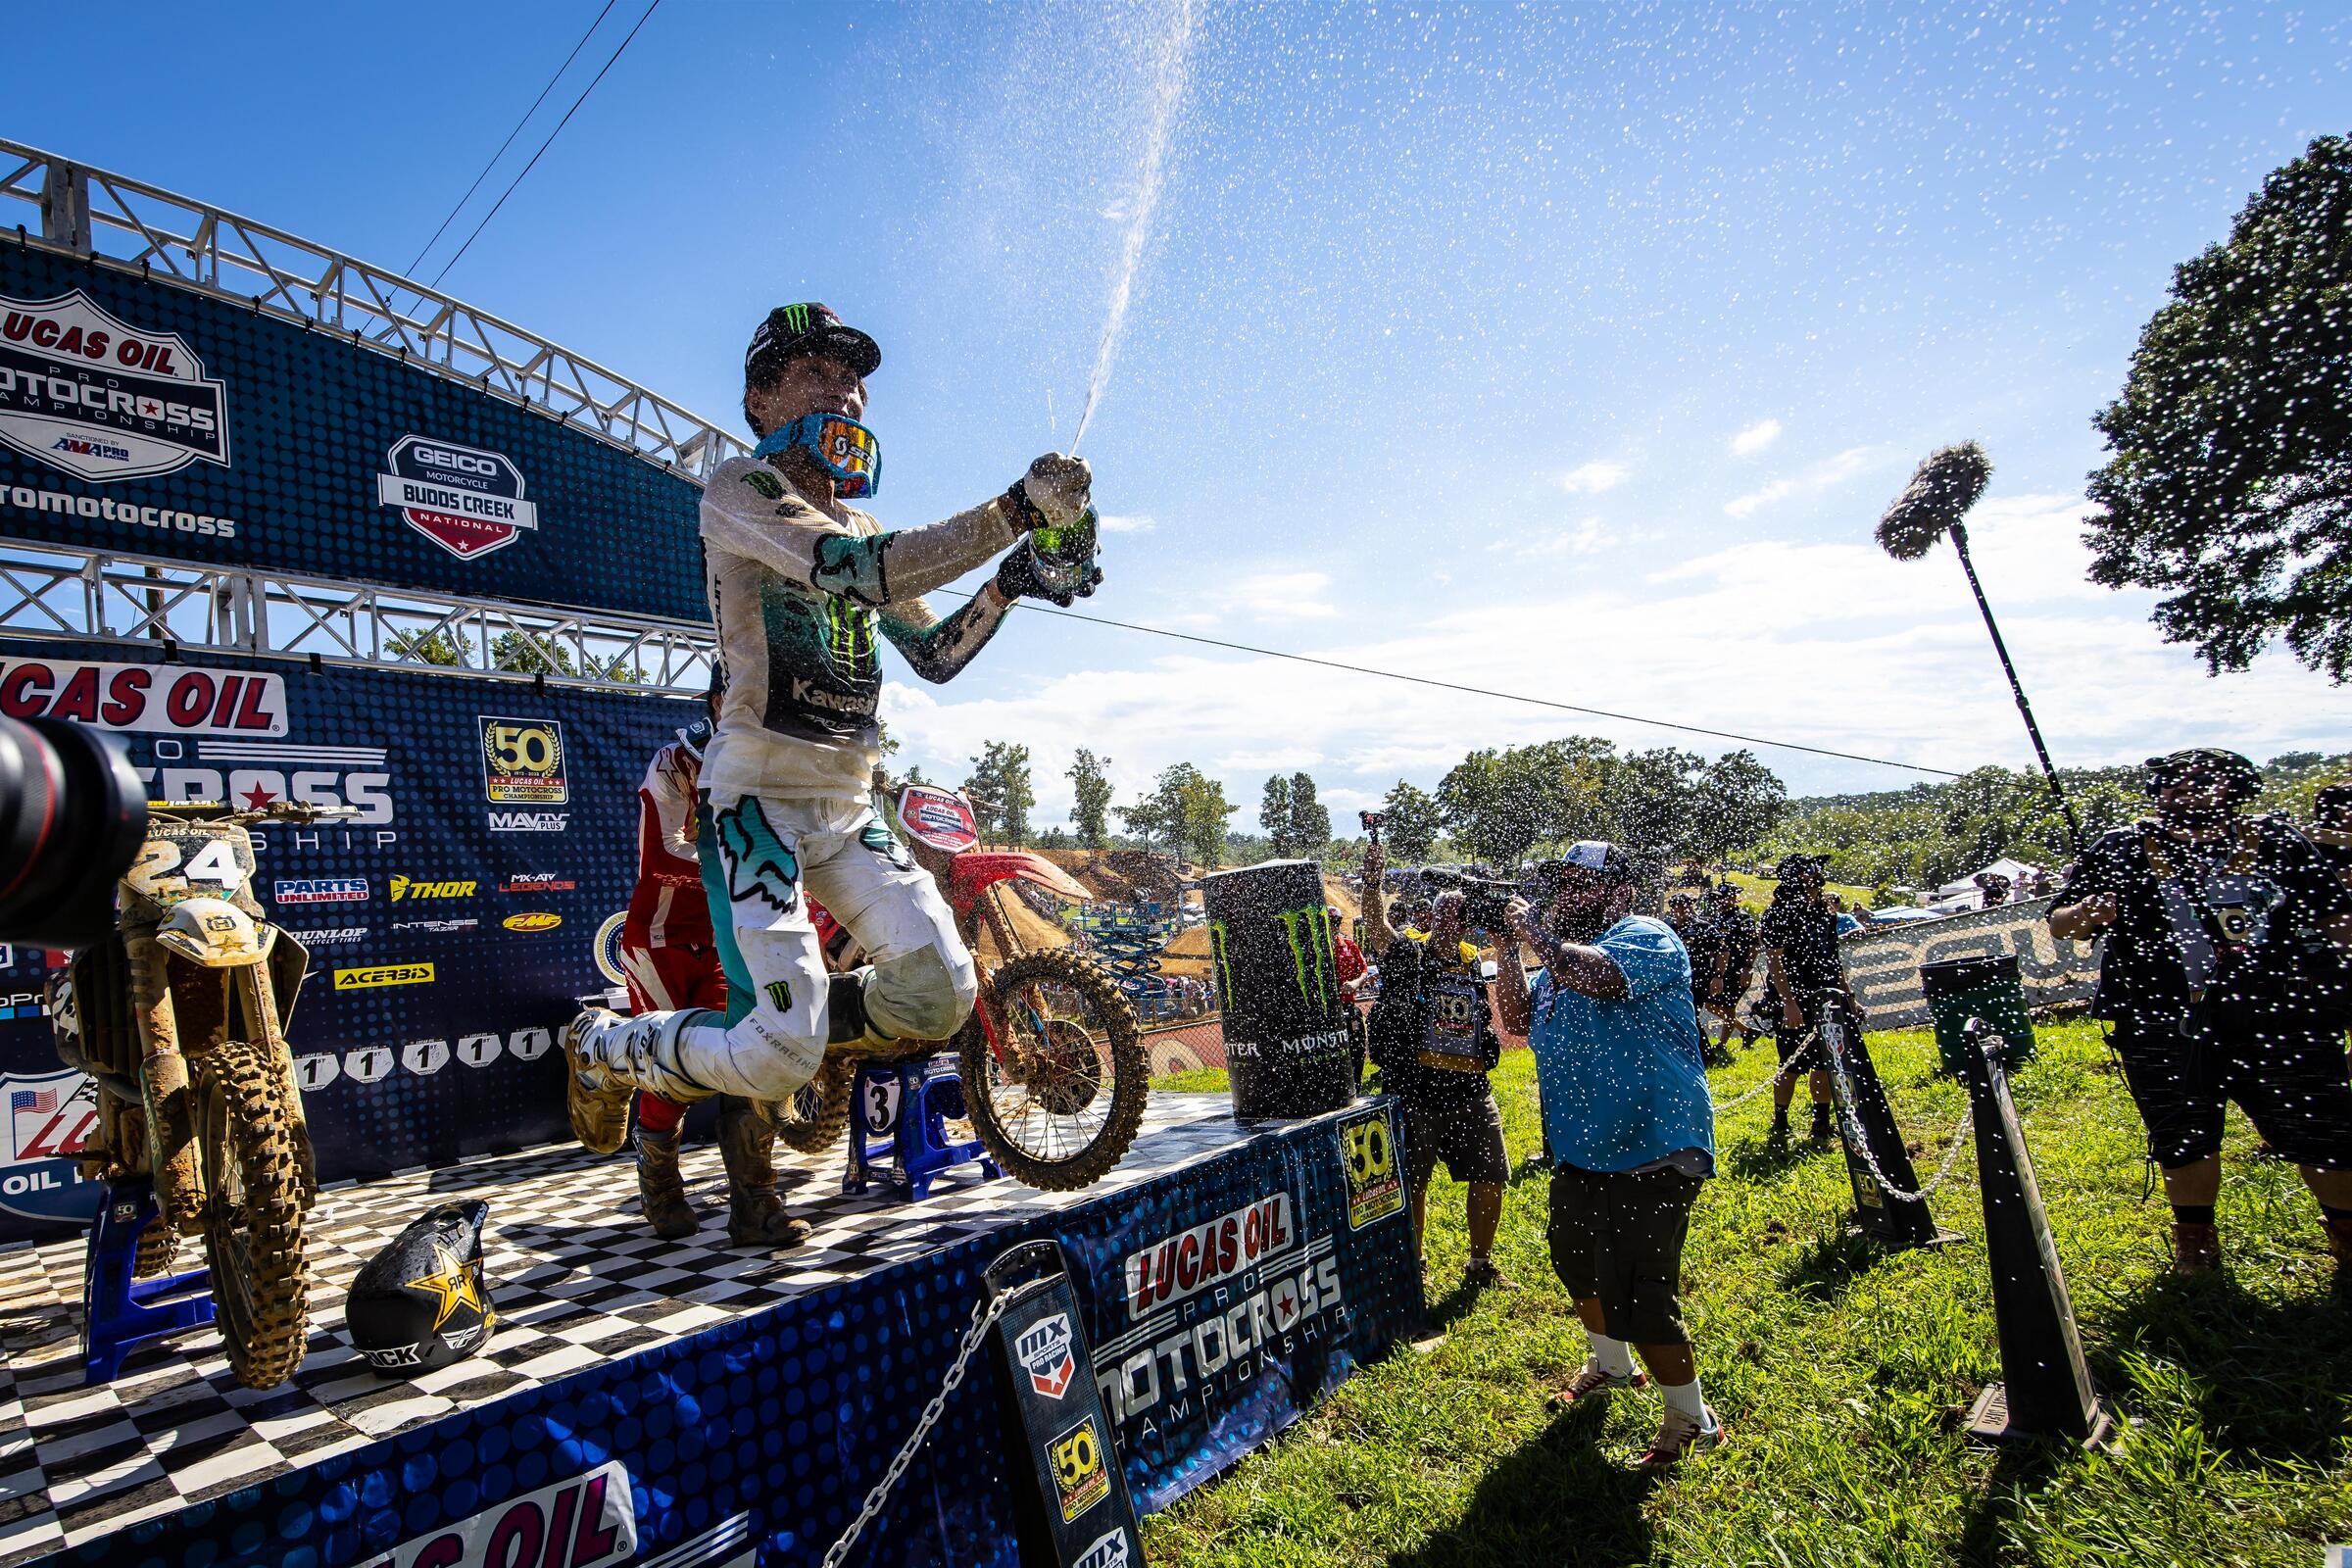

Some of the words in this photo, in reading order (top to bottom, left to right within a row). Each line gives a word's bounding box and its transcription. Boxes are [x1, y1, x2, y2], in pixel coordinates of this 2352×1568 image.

[0, 312, 110, 360] UCAS
[117, 339, 176, 376] OIL
[49, 366, 120, 388] PRO
[51, 437, 103, 458] AMA
[103, 446, 129, 458] PRO
[66, 432, 109, 446] SANCTIONED
[103, 454, 129, 463] RACING
[414, 446, 497, 476] GEICO
[426, 470, 489, 490] MOTORCYCLE
[404, 484, 460, 510] BUDDS
[464, 495, 515, 520] CREEK
[419, 513, 503, 533] NATIONAL
[0, 662, 153, 727] CAS
[166, 671, 274, 731] OIL
[495, 726, 555, 771] 50
[513, 786, 563, 795] MOTOCROSS
[924, 793, 945, 803] LUCAS
[926, 806, 945, 814] LUCAS
[127, 840, 247, 891] 24
[276, 879, 368, 895] PARTS
[498, 881, 576, 893] LEGENDS
[511, 873, 557, 883] MX-ATV
[276, 892, 368, 903] UNLIMITED
[411, 882, 477, 899] THOR
[392, 919, 478, 929] INTENSE
[505, 914, 562, 929] FMF
[290, 927, 368, 941] DUNLOP
[869, 1086, 890, 1130] 3
[1348, 1120, 1388, 1183] 50
[3, 1171, 61, 1195] OIL
[118, 1204, 133, 1215] 50
[1353, 1203, 1363, 1216] PRO
[1364, 1190, 1399, 1211] MOTOCROSS
[1137, 1217, 1238, 1313] LUCAS
[1244, 1198, 1288, 1260] OIL
[1184, 1273, 1255, 1322] PRO
[1021, 1315, 1067, 1359] MX
[1032, 1357, 1045, 1370] PRO
[1045, 1345, 1066, 1363] RACING
[1033, 1339, 1061, 1358] SPORTS
[1114, 1305, 1348, 1450] HAMPIONSHIP
[1057, 1432, 1096, 1486] 50
[1065, 1501, 1077, 1513] PRO
[1077, 1478, 1107, 1502] MOTOCROSS
[1074, 1484, 1089, 1497] LUCAS
[483, 1471, 620, 1568] OIL
